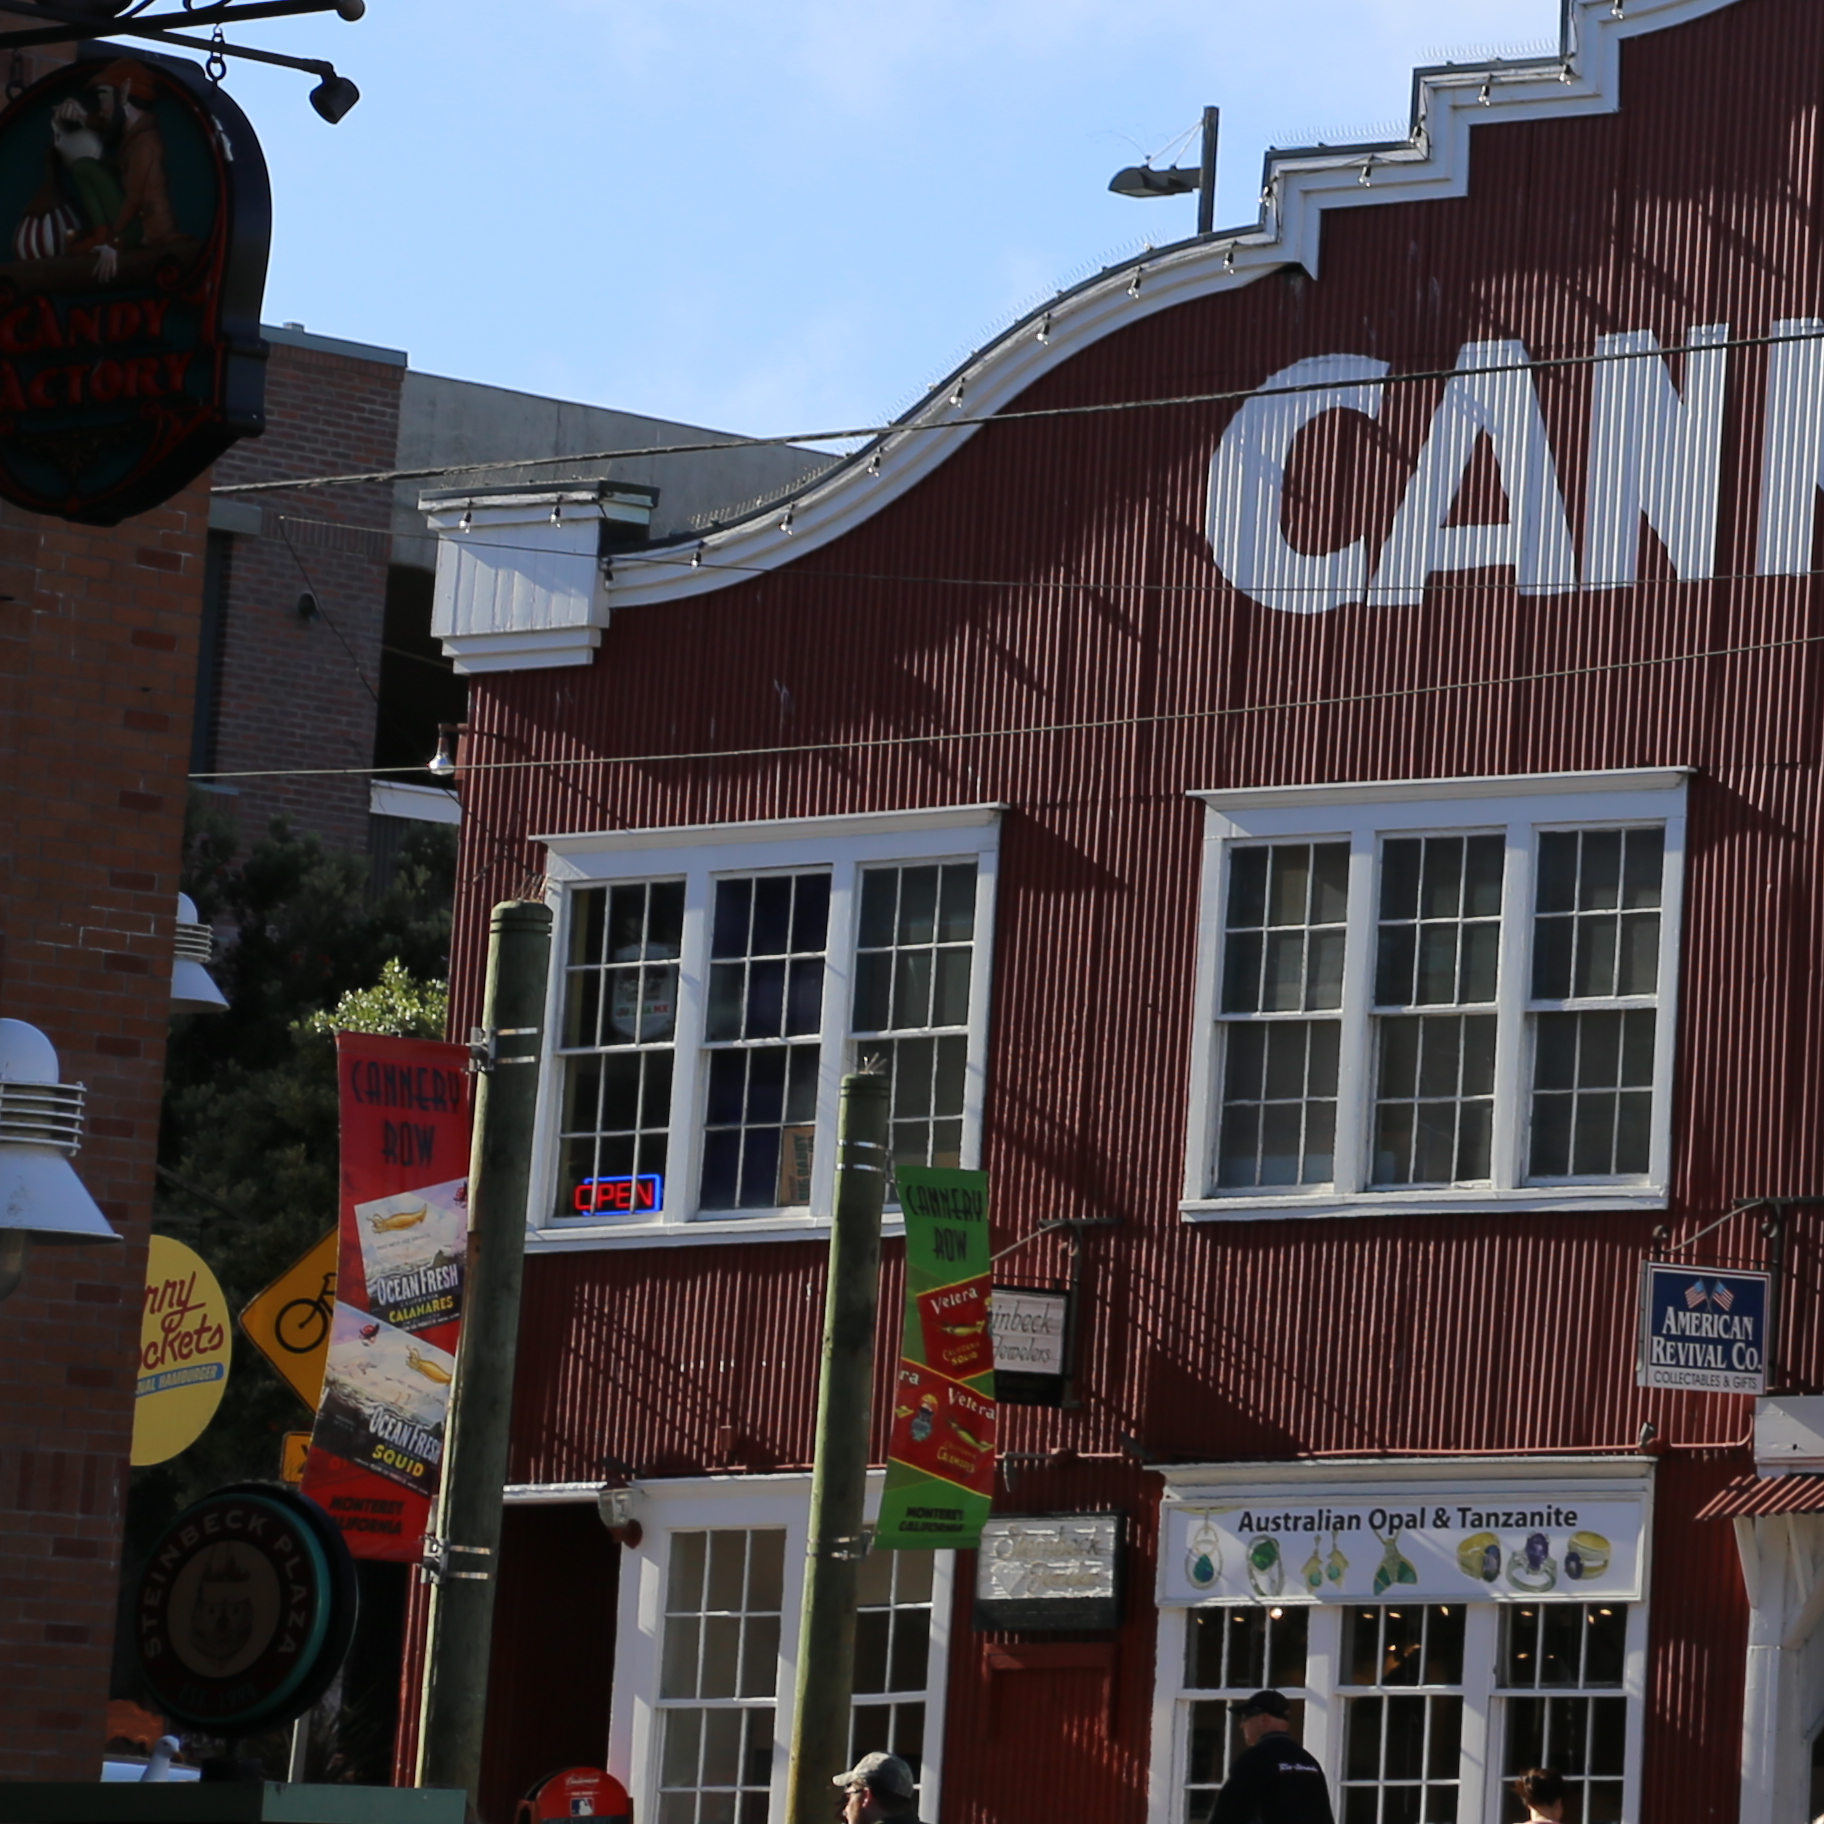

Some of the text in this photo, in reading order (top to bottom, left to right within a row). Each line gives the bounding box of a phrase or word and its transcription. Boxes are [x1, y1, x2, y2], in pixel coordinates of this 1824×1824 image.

[0, 296, 170, 353] CANDY
[0, 352, 194, 411] ACTORY
[352, 1060, 460, 1114] CANNERY
[381, 1120, 436, 1168] ROW
[574, 1182, 654, 1211] OPEN
[906, 1184, 983, 1222] CANNERY
[932, 1227, 967, 1261] ROW
[144, 1271, 206, 1333] nny
[376, 1264, 459, 1306] OCEAN FRESH
[389, 1296, 454, 1323] CALAMARES
[993, 1300, 1053, 1333] inbeck
[1662, 1306, 1753, 1340] AMERICAN
[141, 1314, 224, 1370] ckets
[1651, 1336, 1727, 1369] REVIVAL
[1654, 1371, 1757, 1389] COLLECTABLES & GIFTS
[369, 1406, 412, 1448] OCEAN
[372, 1444, 425, 1477] SQUID
[335, 1516, 402, 1535] ALIFORNIA
[1238, 1505, 1578, 1535] Australian Opal & Tanzanite
[141, 1509, 307, 1659] STEINBECK PLAZA
